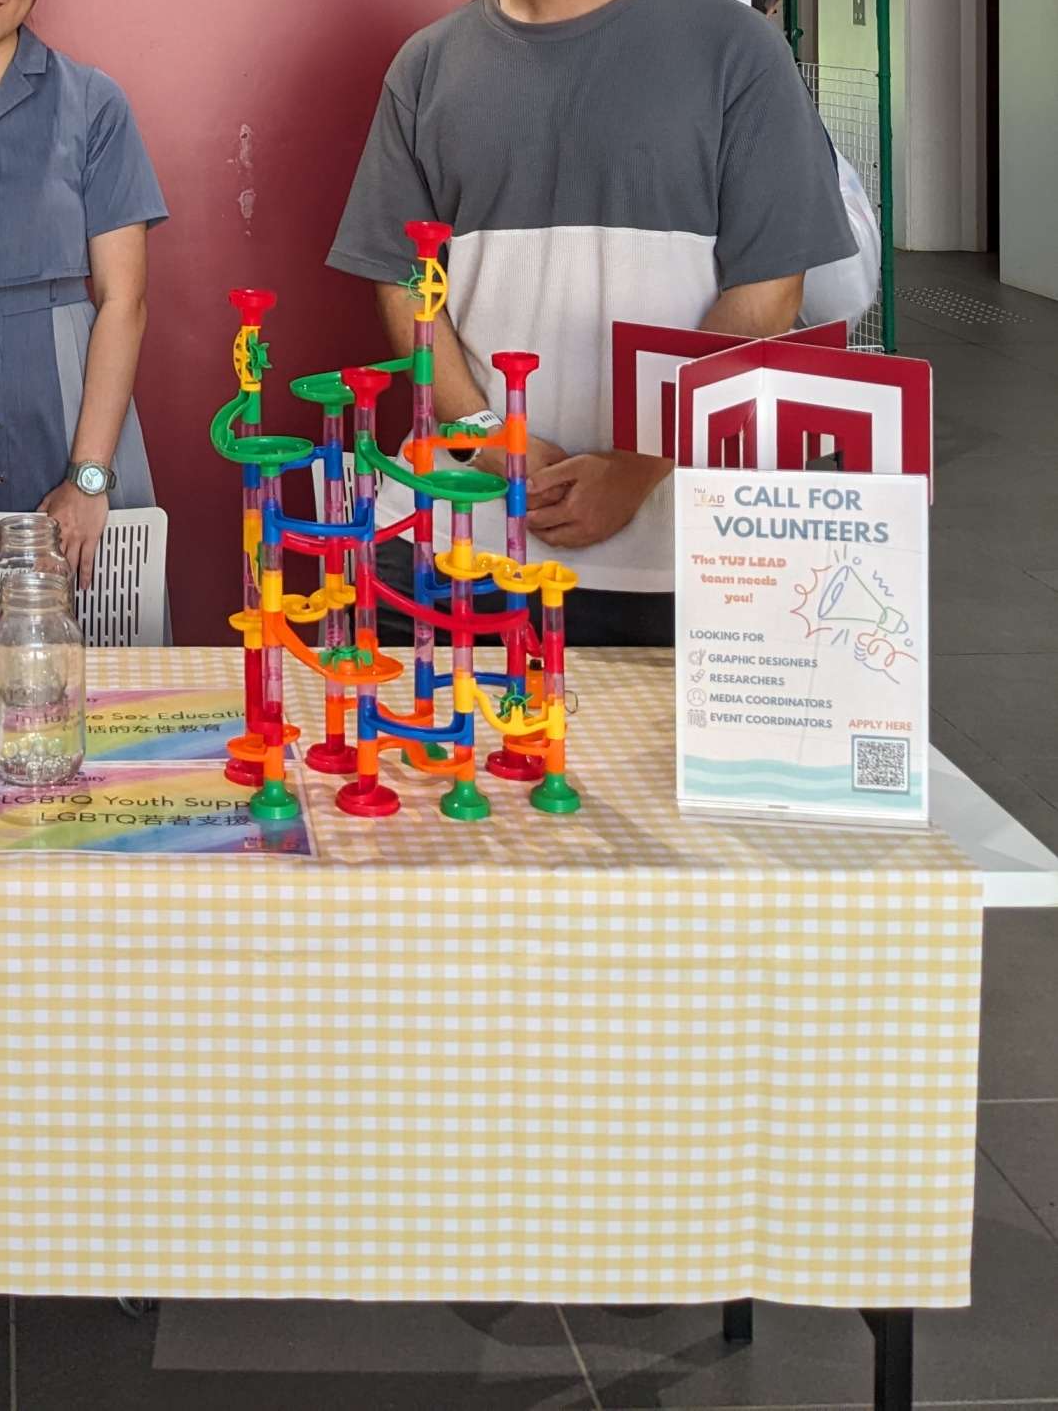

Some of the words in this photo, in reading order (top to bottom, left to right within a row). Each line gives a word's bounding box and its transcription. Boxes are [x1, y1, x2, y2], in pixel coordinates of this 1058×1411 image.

[734, 485, 801, 509] CALL
[808, 488, 863, 511] FOR
[713, 515, 889, 543] VOLUNTEERS
[691, 554, 716, 566] The
[719, 555, 746, 567] TUJ
[748, 556, 786, 568] LEAD
[701, 575, 735, 585] team
[737, 574, 778, 587] needs
[724, 592, 753, 605] you!
[689, 630, 741, 642] LOOKING
[743, 632, 765, 643] FOR
[708, 654, 756, 666] GRAPHIC
[758, 656, 818, 668] DESIGNERS
[709, 674, 785, 686] RESEARCHERS
[709, 693, 743, 705] MEDIA
[745, 695, 833, 709] COORDINATORS
[110, 712, 150, 721] Sex
[157, 710, 246, 721] Educati
[710, 713, 743, 725] EVENT
[745, 715, 833, 729] COORDINATORS
[848, 719, 883, 731] APPLY
[885, 720, 913, 732] HERE
[103, 795, 174, 807] Youth
[184, 796, 251, 810] Supp
